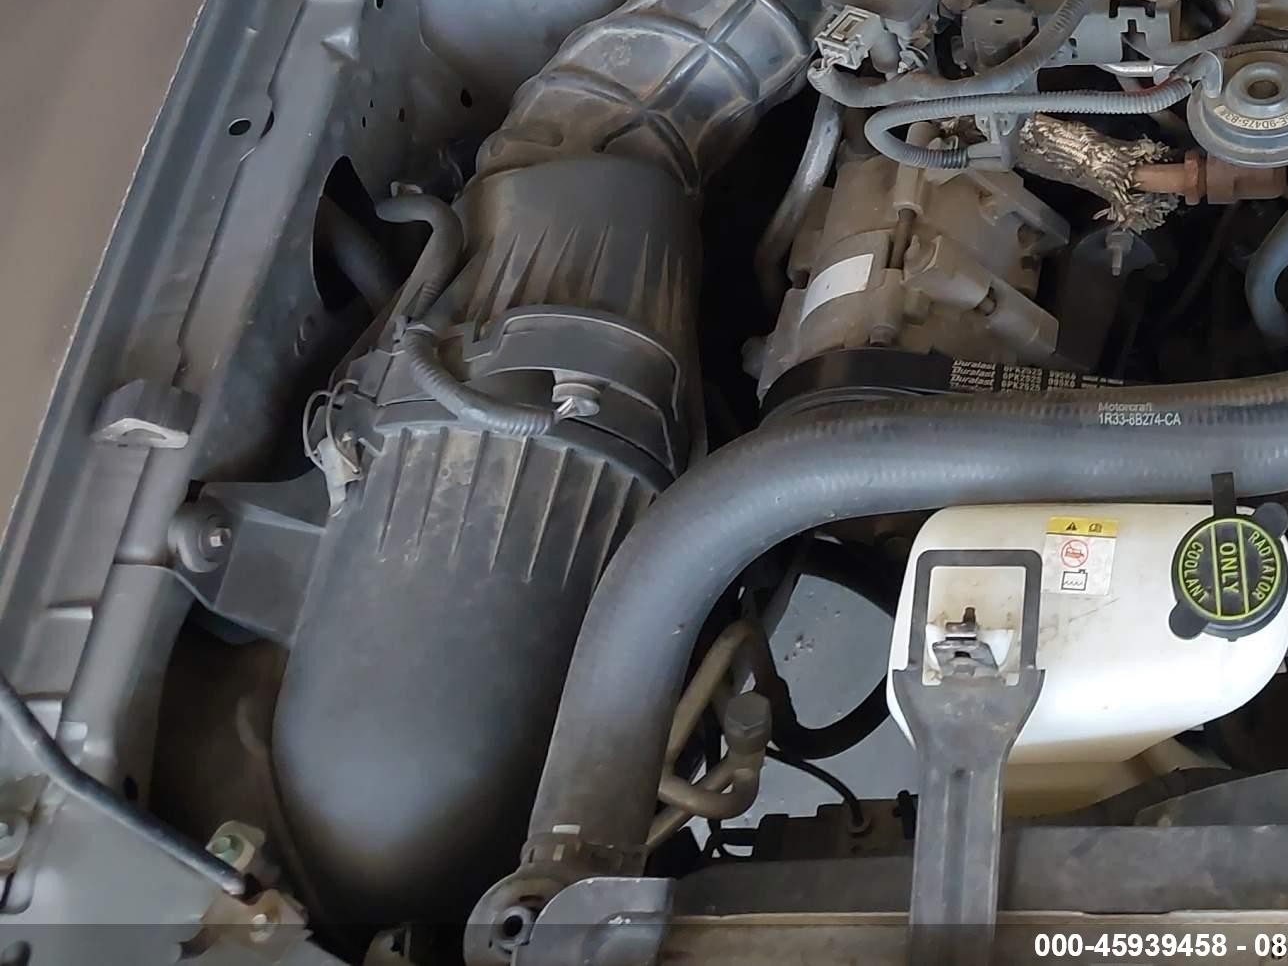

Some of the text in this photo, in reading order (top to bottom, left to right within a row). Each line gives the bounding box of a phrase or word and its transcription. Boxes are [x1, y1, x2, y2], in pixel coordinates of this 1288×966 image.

[1098, 401, 1153, 412] Motorcraft
[1183, 541, 1210, 604] COOLANT
[1219, 542, 1240, 594] ONLY
[1248, 530, 1276, 601] RADIATOR
